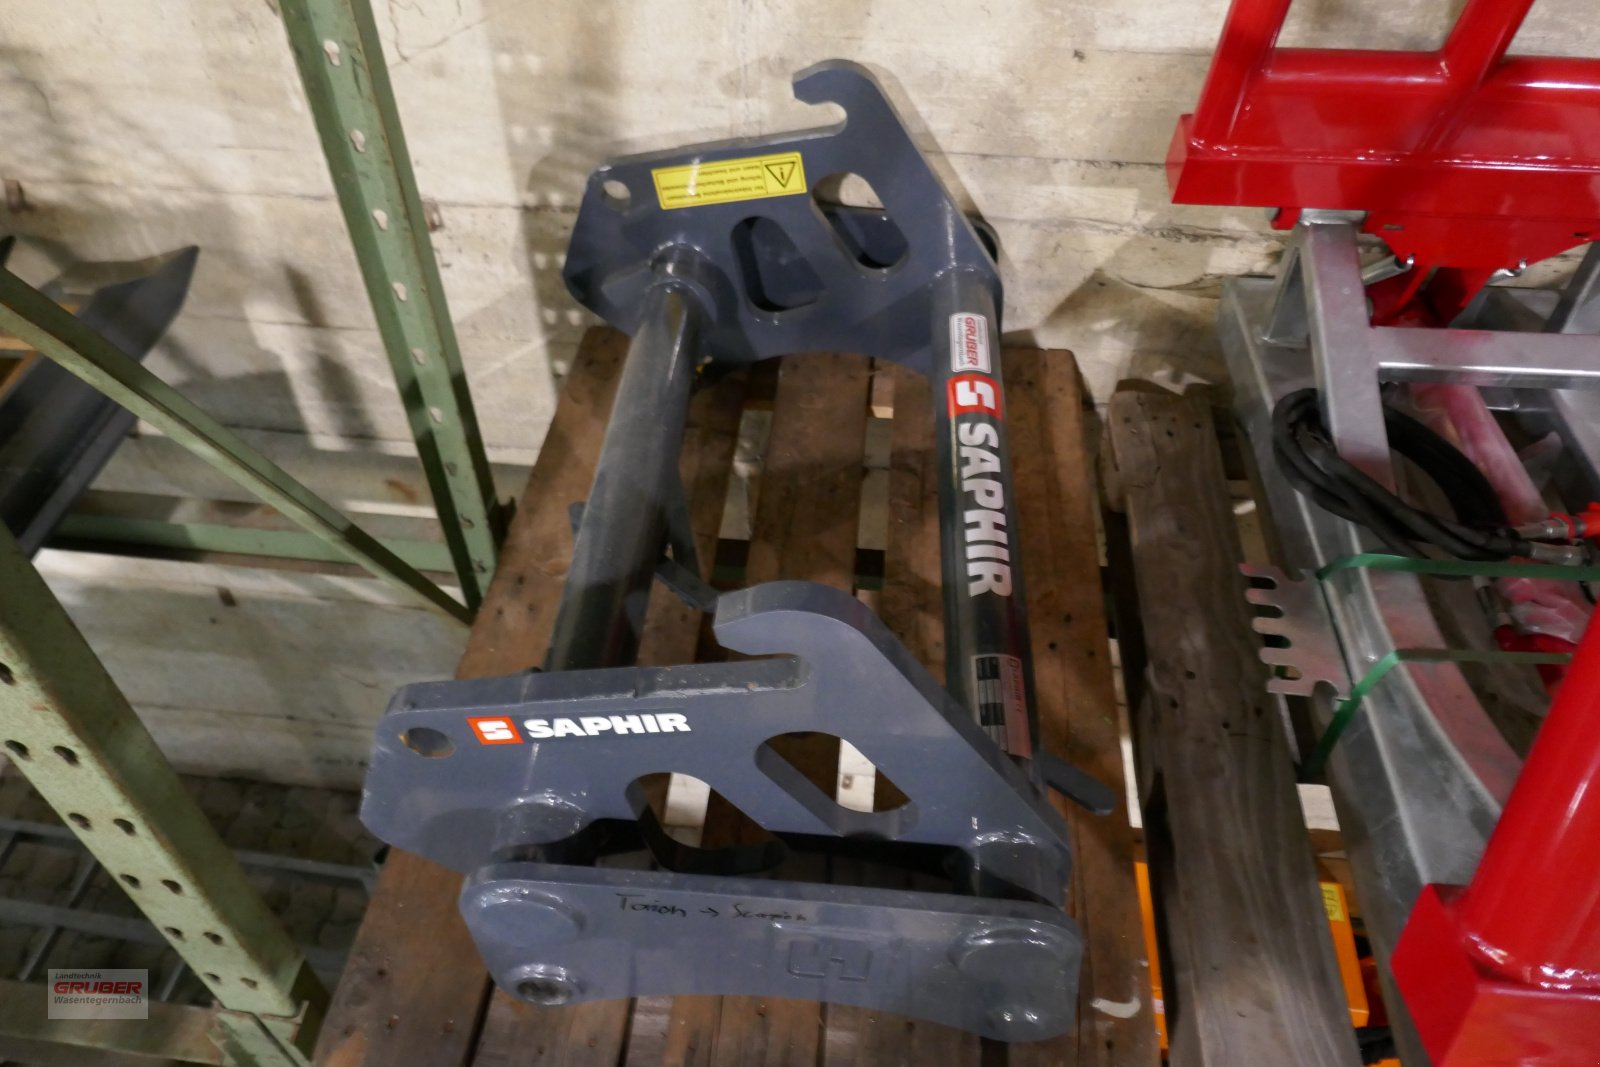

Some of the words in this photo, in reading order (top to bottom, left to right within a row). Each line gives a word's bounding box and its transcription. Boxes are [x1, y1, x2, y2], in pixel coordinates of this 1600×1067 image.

[965, 317, 979, 366] GRUBER
[958, 422, 1013, 598] SAPHIR
[523, 712, 692, 739] SAPHIR
